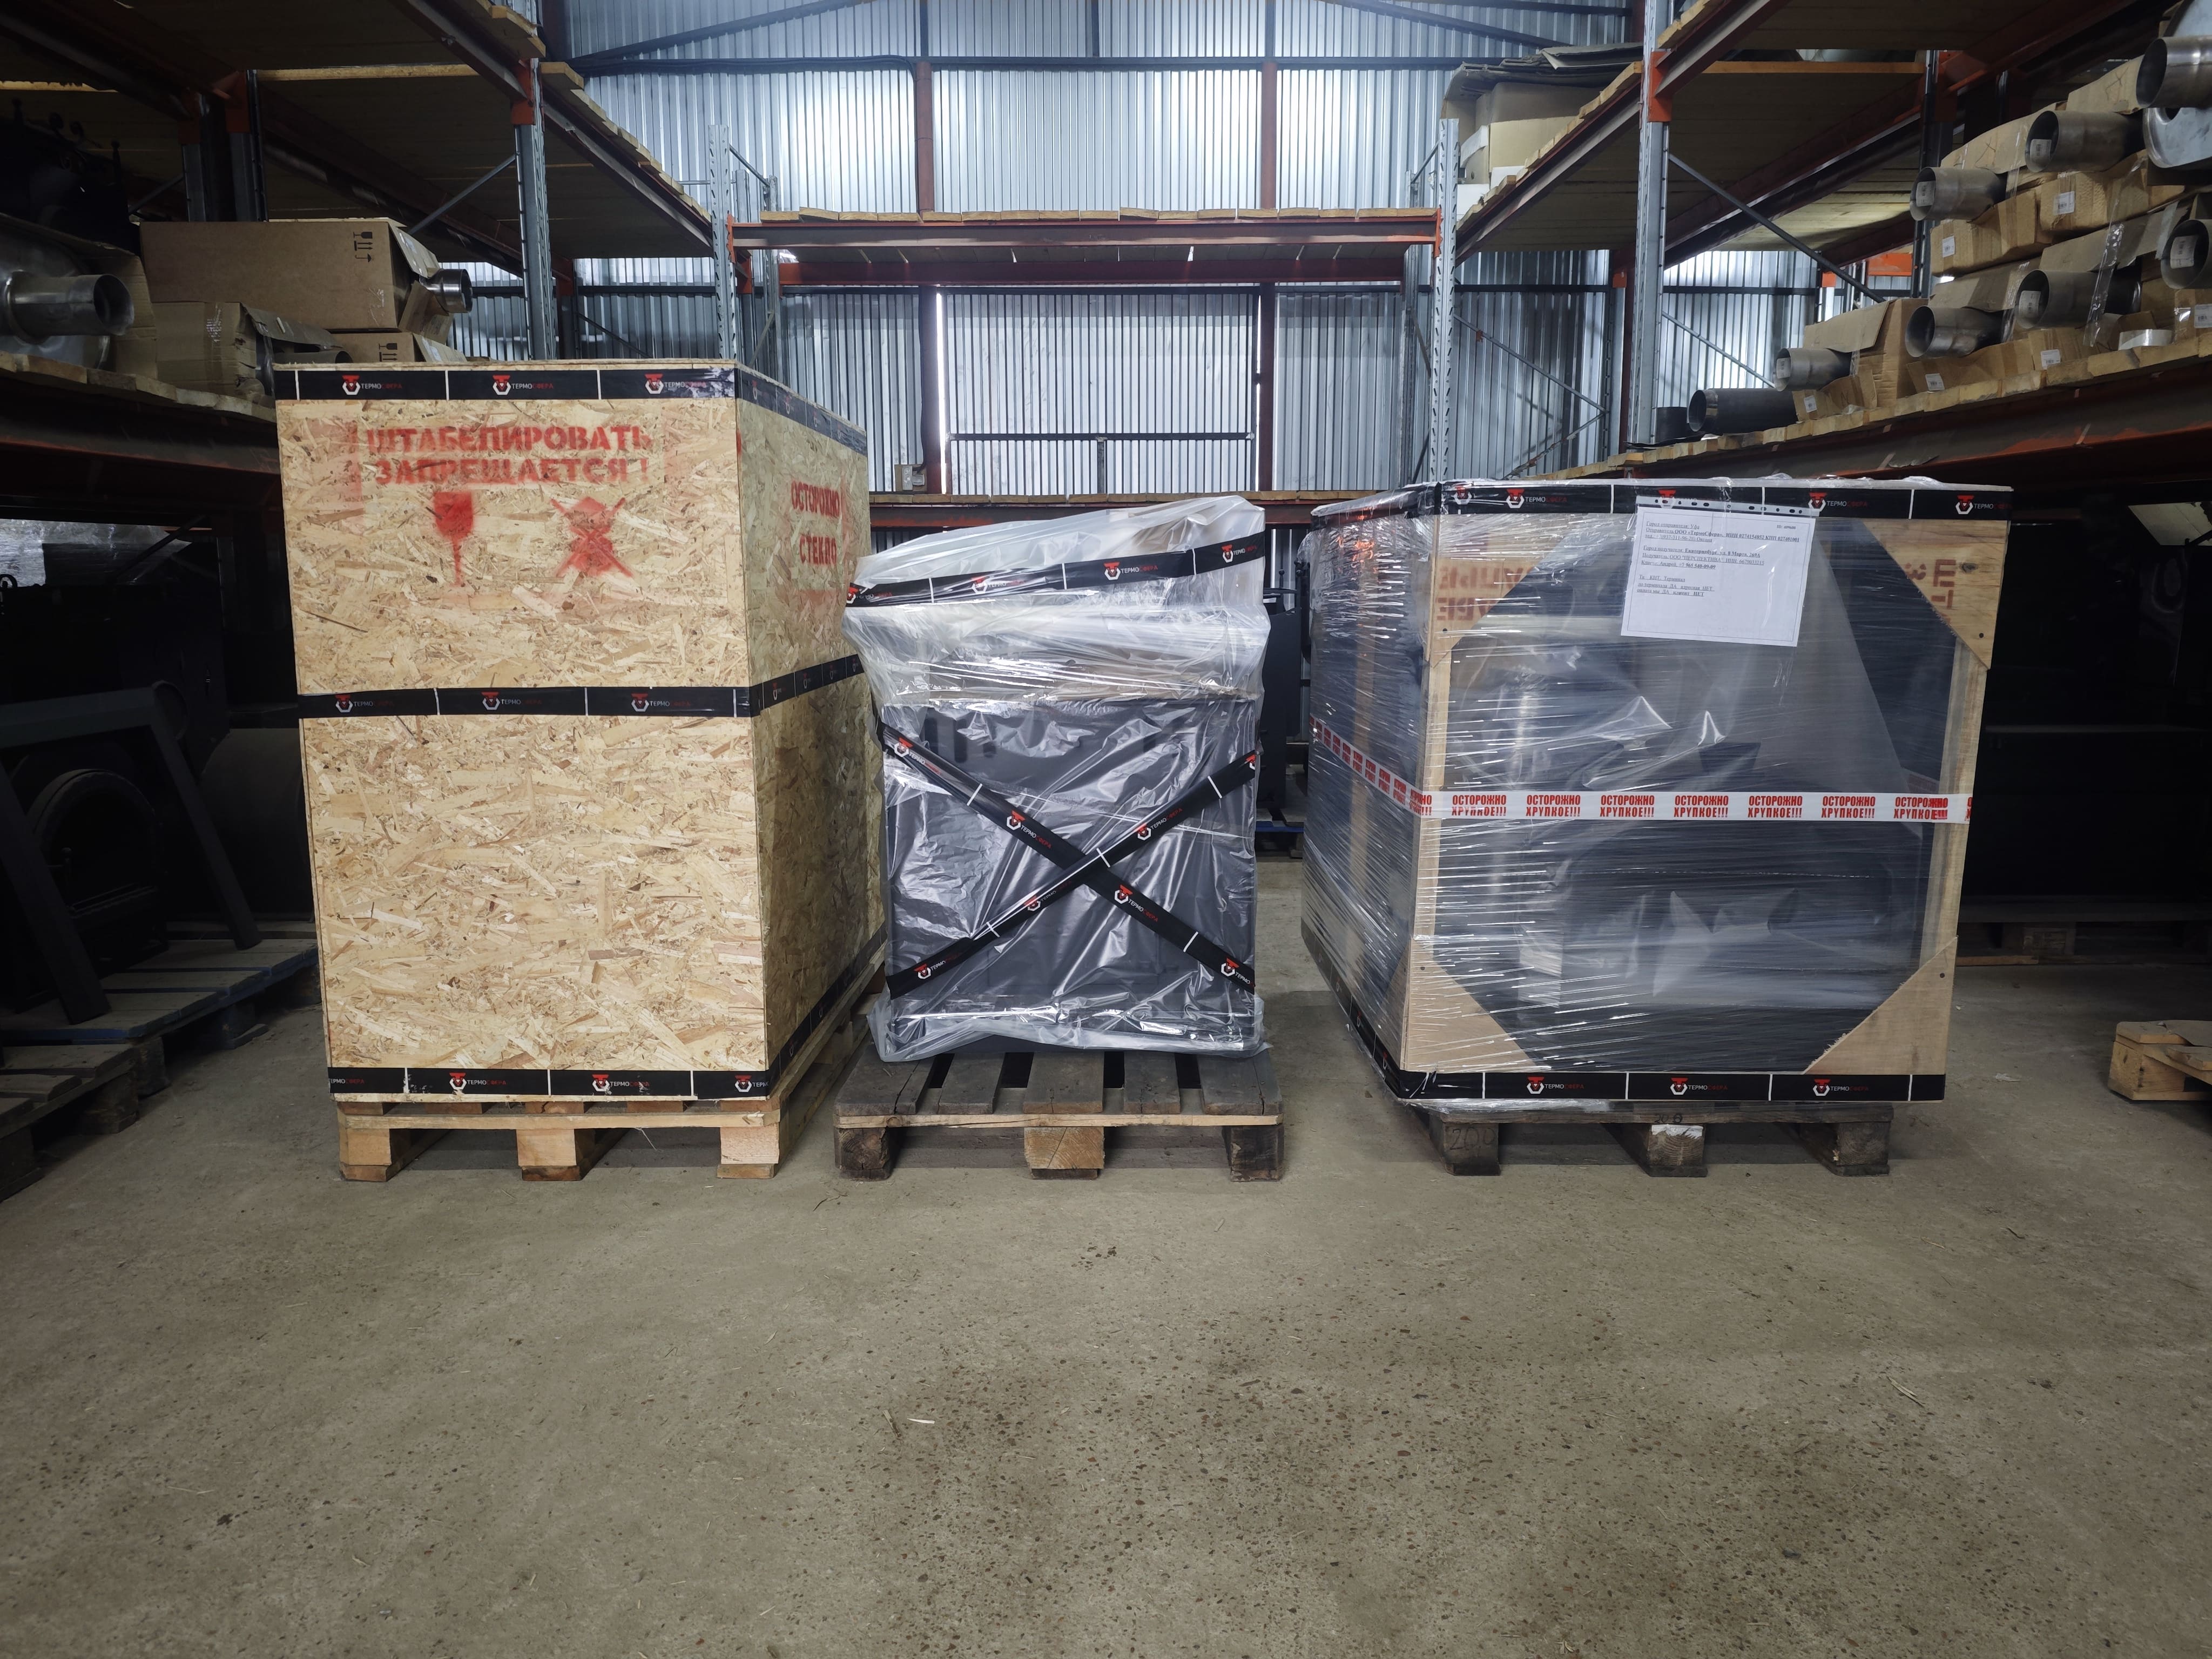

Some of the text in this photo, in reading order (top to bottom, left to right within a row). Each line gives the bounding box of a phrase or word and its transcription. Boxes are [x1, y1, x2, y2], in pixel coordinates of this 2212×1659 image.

[367, 425, 652, 453] ШТАБЕЛИРОВАТЬ
[375, 458, 628, 484] ЗАПРЕЩАЕТСЯ
[791, 480, 840, 517] ОСТОРОЖНО
[799, 534, 837, 566] СТЕКЛО
[1452, 794, 1507, 805] ОСТОРОЖНО
[1526, 795, 1581, 806] ОСТОРОЖНО
[1601, 795, 1655, 806] ОСТОРОЖНО
[1675, 795, 1729, 806] ОСТОРОЖНО
[1749, 795, 1803, 806] ОСТОРОЖНО
[1822, 795, 1876, 807] ОСТОРОЖНО
[1451, 806, 1507, 817] ХРУПКОЕ!!!
[1526, 806, 1581, 817] ХРУПКОЕ!!!
[1600, 807, 1654, 818] ХРУПКОЕ!!!
[1674, 807, 1728, 818] ХРУПКОЕ!!!
[1748, 807, 1802, 818] ХРУПКОЕ!!!
[1821, 808, 1875, 819] ХРУПКОЕ!!!
